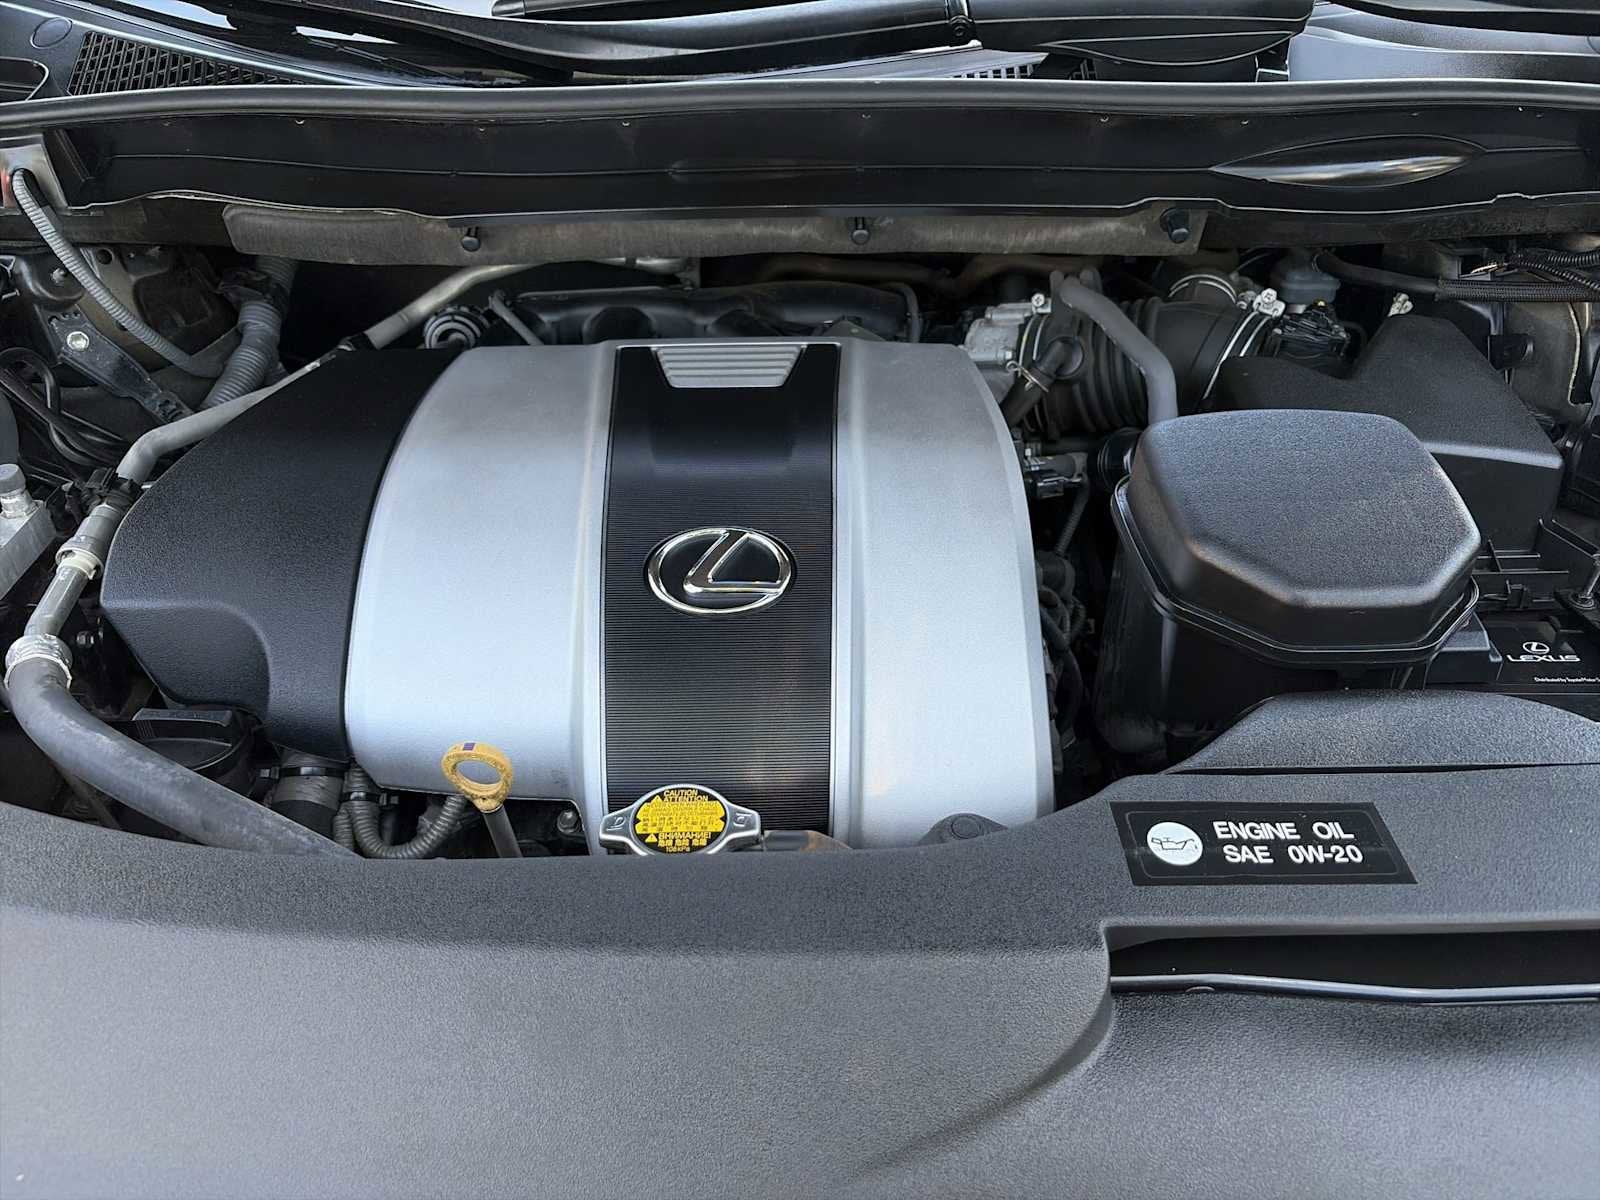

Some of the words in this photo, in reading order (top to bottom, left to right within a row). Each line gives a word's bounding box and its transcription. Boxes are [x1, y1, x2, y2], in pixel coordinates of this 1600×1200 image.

[1506, 654, 1581, 662] LEXUS
[663, 789, 698, 797] CAUTION
[1212, 820, 1301, 841] ENGINE
[1312, 821, 1355, 840] OIL
[1222, 845, 1274, 864] SAE
[1287, 845, 1363, 864] 0W-20
